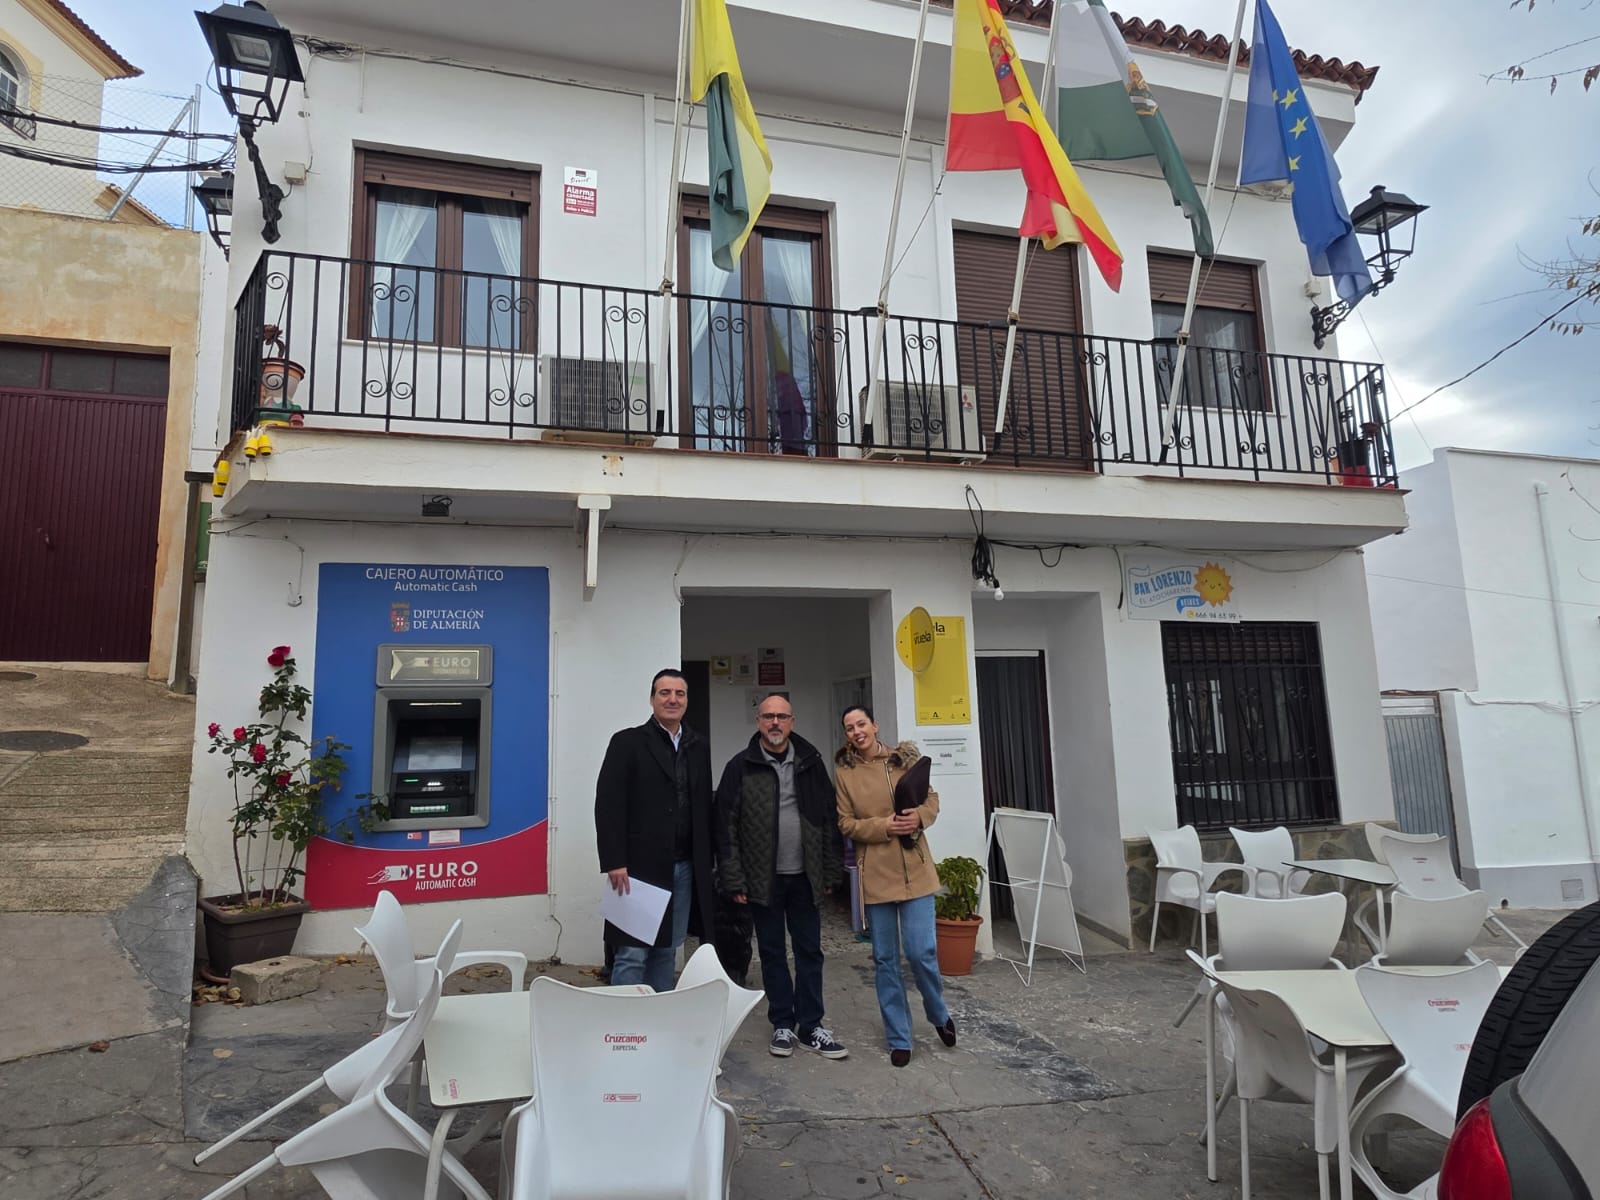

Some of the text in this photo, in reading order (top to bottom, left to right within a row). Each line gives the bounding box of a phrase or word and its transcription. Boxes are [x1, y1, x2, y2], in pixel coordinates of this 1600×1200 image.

[566, 187, 595, 197] Alarma
[366, 566, 504, 581] CAJERO AUTOMÁTICO
[394, 581, 478, 592] Automatic Cash
[1134, 570, 1192, 595] BAR LORENZO
[413, 608, 484, 619] DIPUTACIÓN
[413, 619, 481, 630] DE ALMERÍA
[432, 657, 471, 668] EURO
[415, 861, 478, 878] EURO
[415, 878, 476, 890] AUTOMATIC CASH
[604, 1033, 647, 1044] Cruzcampo
